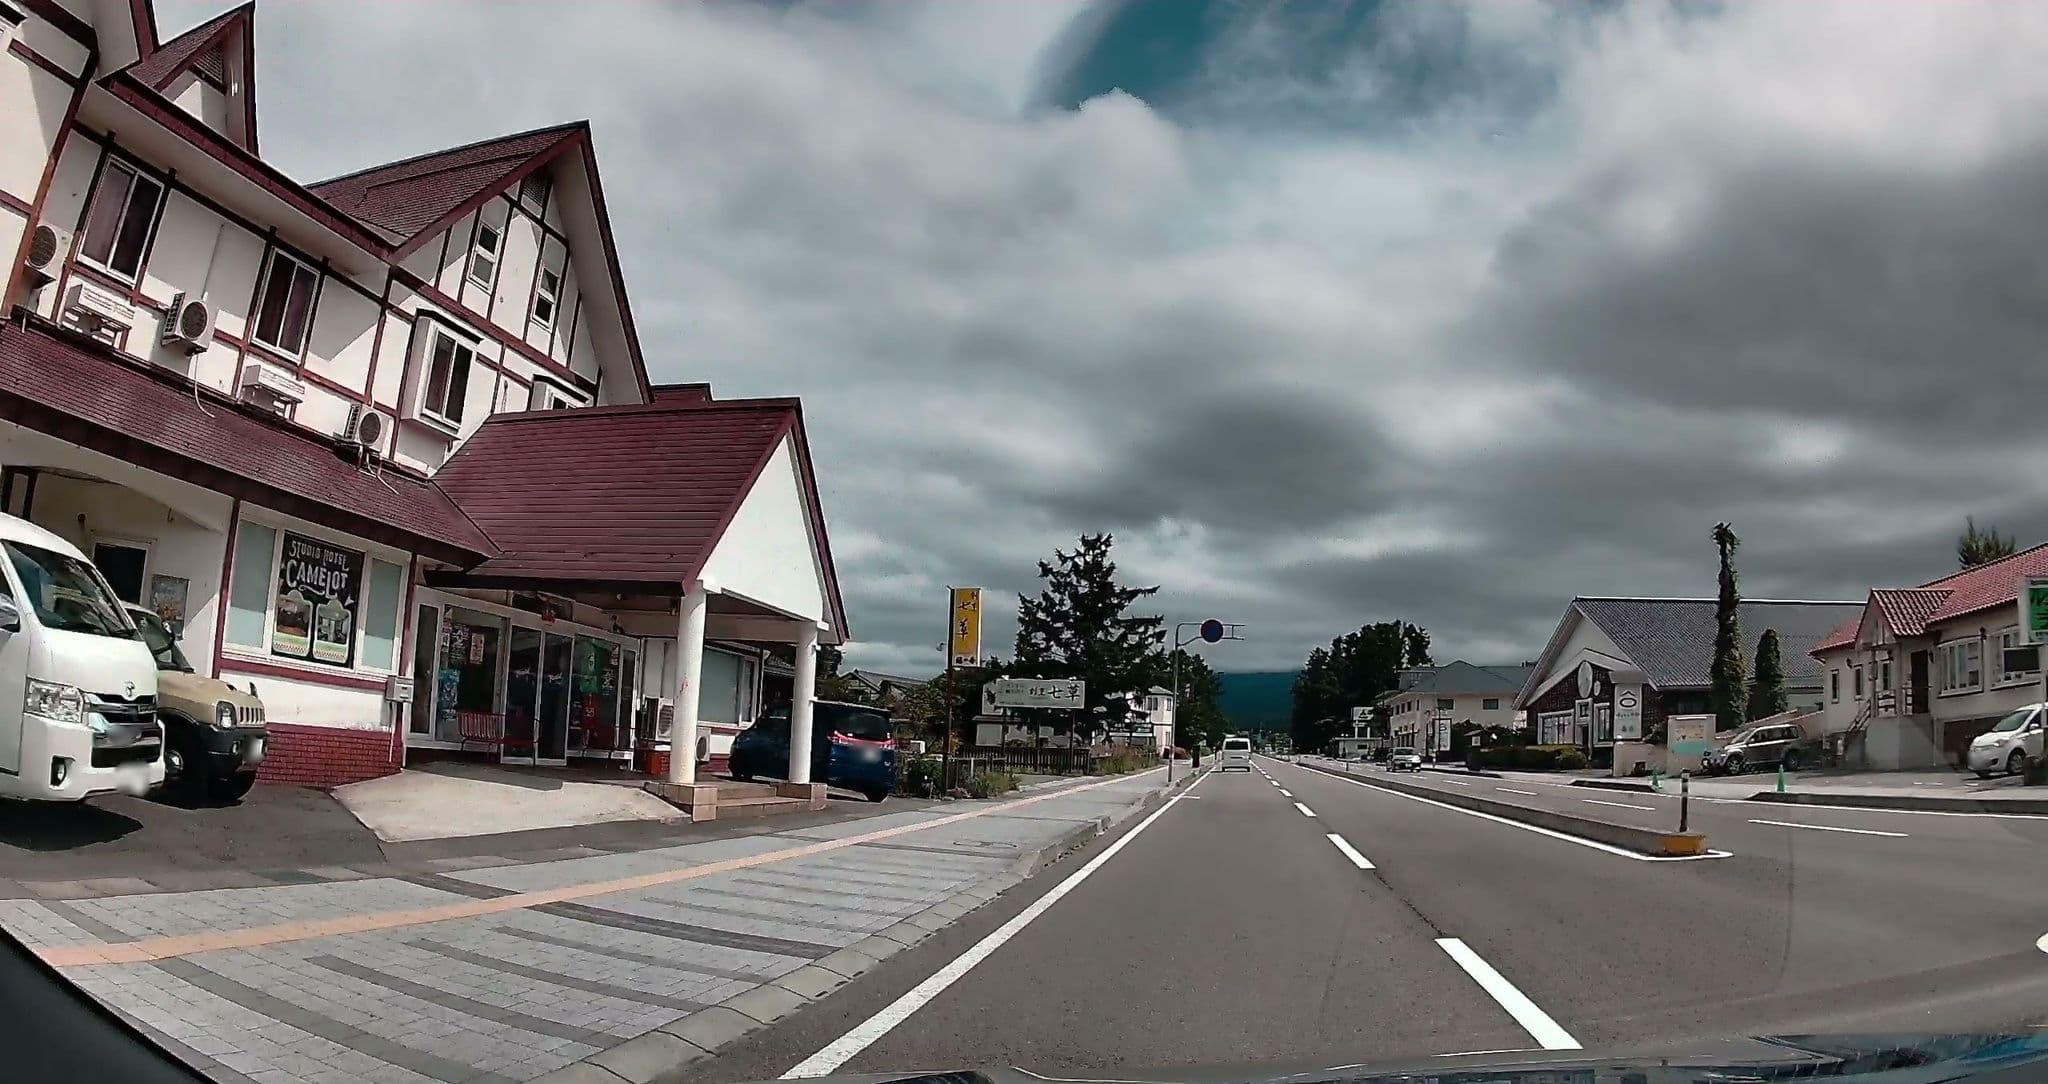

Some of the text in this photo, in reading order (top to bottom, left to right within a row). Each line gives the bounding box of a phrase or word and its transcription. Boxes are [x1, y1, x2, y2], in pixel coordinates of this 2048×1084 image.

[289, 541, 349, 571] STUDIO HOTEL
[286, 559, 348, 599] CAMELOT
